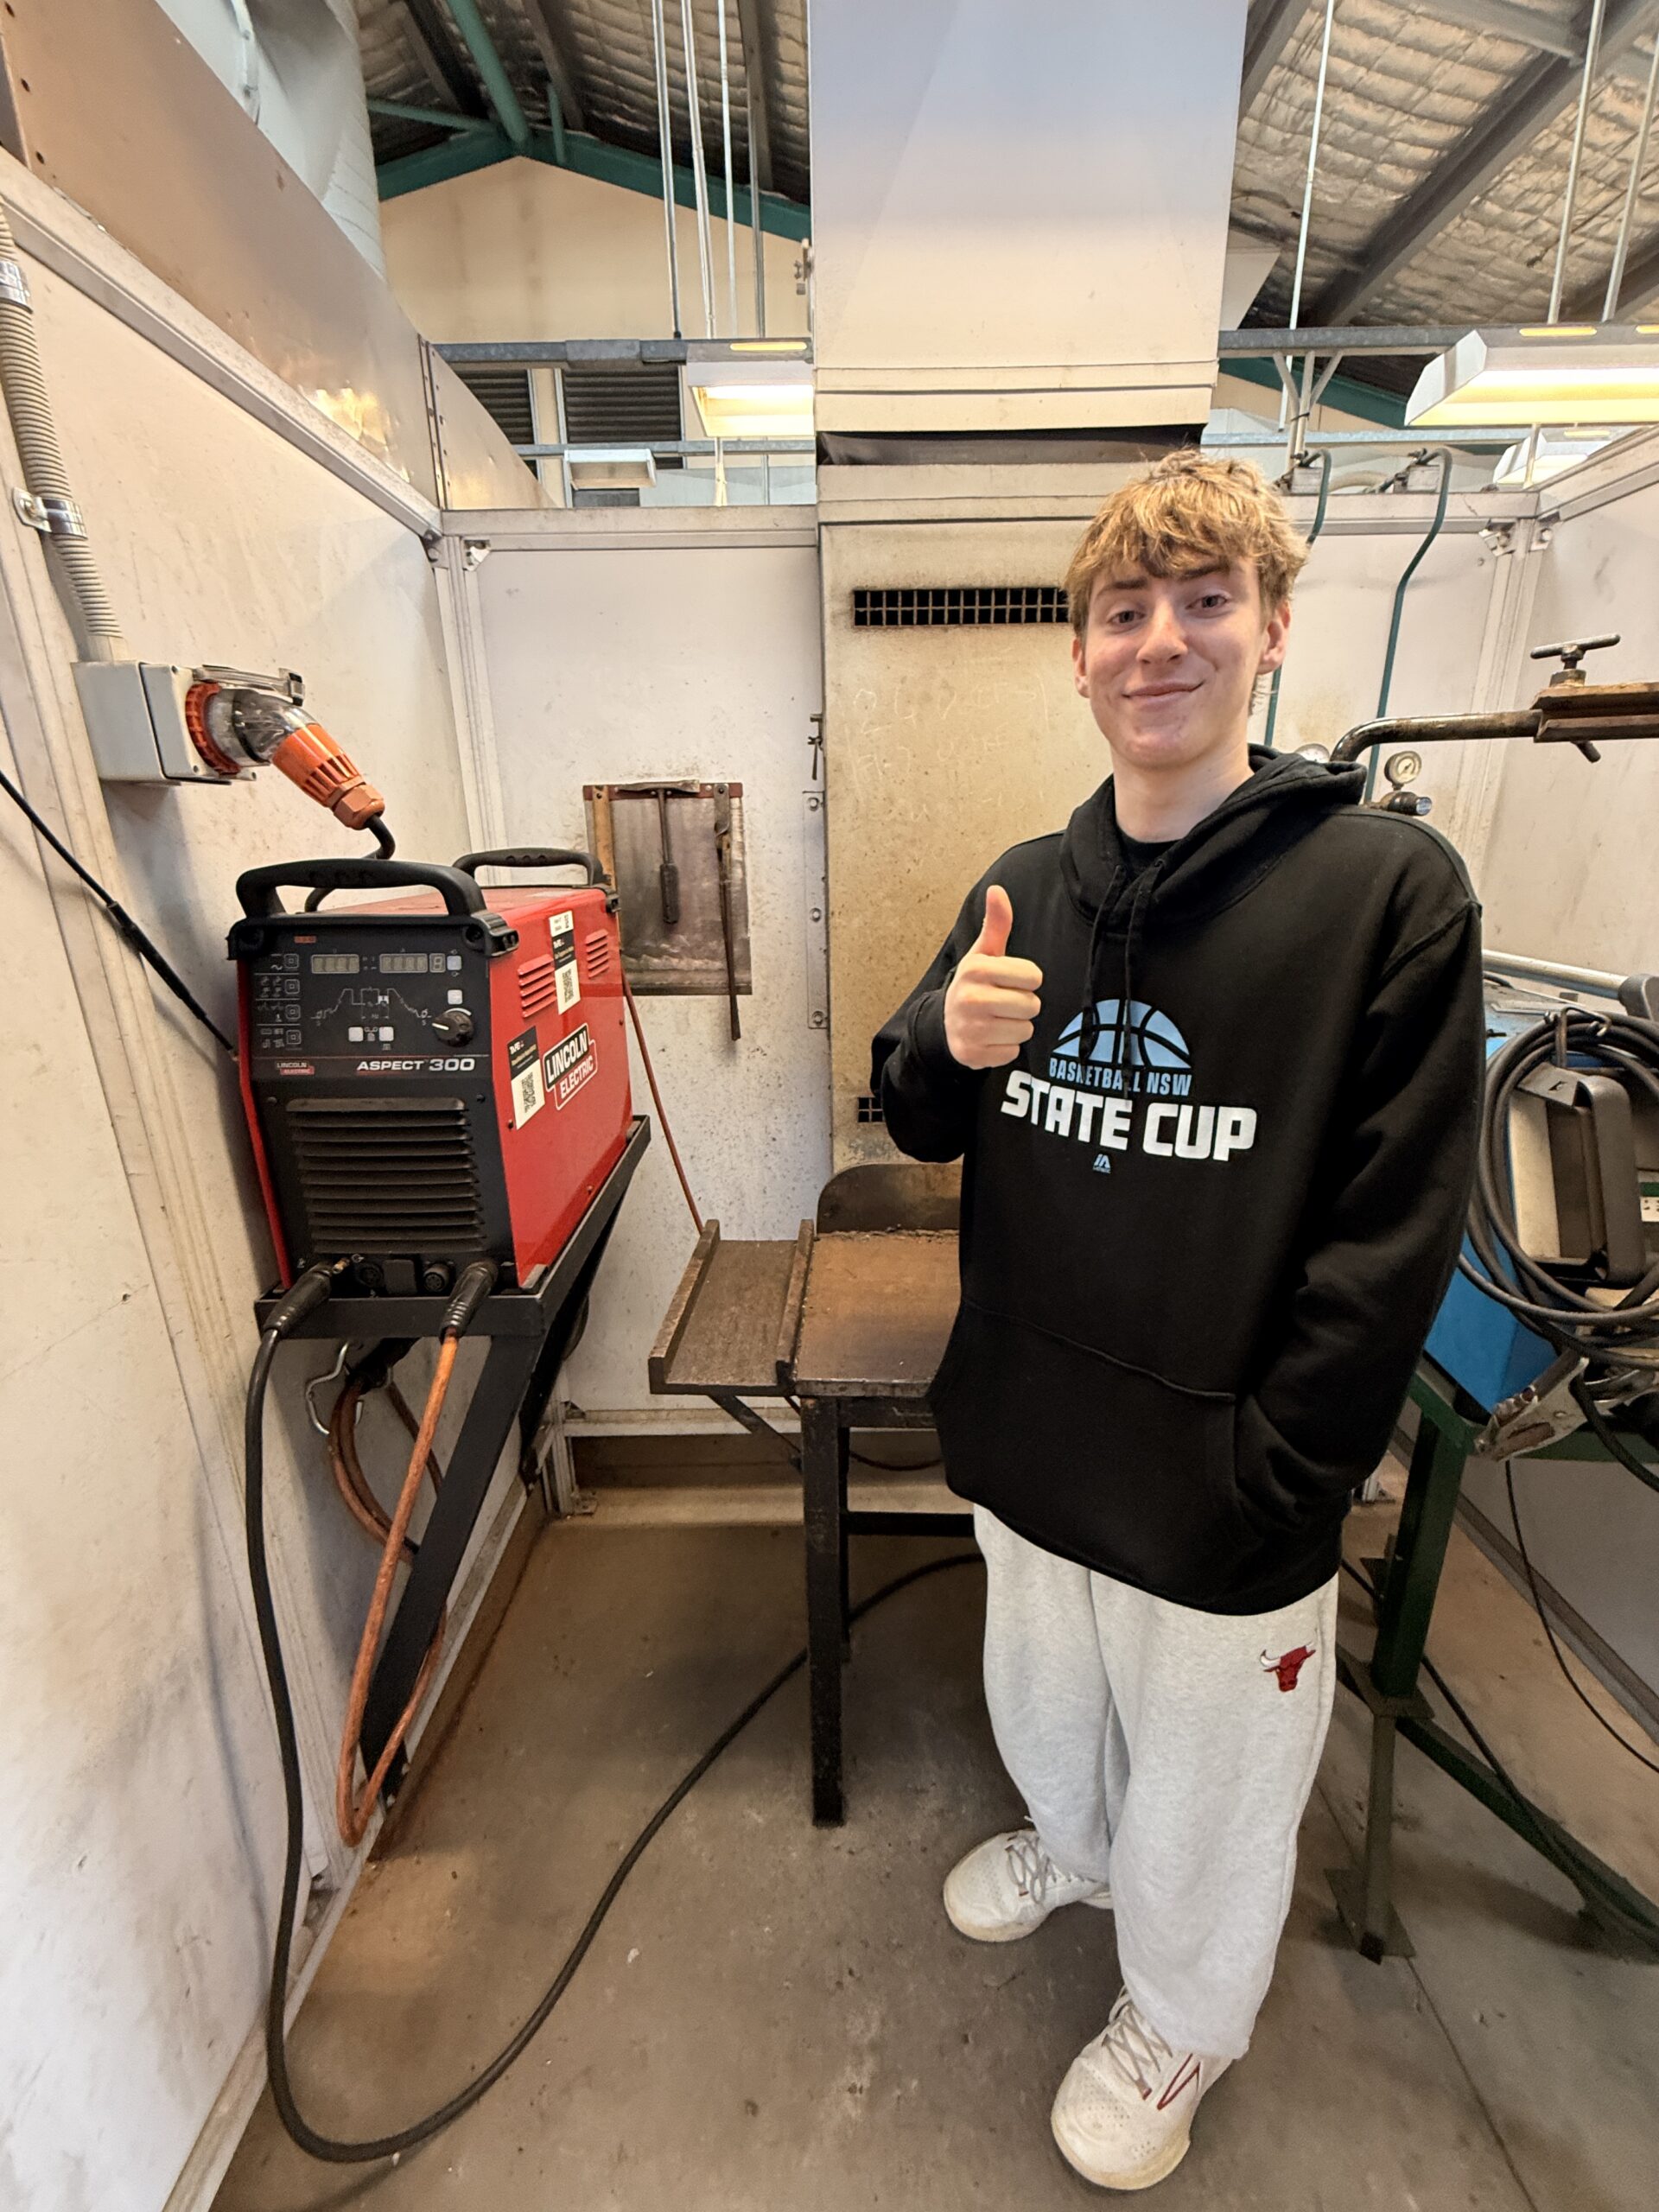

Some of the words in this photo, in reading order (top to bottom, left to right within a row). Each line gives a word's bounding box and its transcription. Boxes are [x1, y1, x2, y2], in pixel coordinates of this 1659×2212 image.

[356, 1060, 424, 1071] ASPECT
[429, 1058, 475, 1071] 300
[546, 1030, 588, 1084] LINCOLN
[560, 1055, 594, 1099] ELECTRIC
[1049, 1058, 1141, 1093] BASKETBAL
[1147, 1071, 1192, 1096] NSW
[1001, 1070, 1133, 1150] STATE
[1142, 1102, 1257, 1161] CUP
